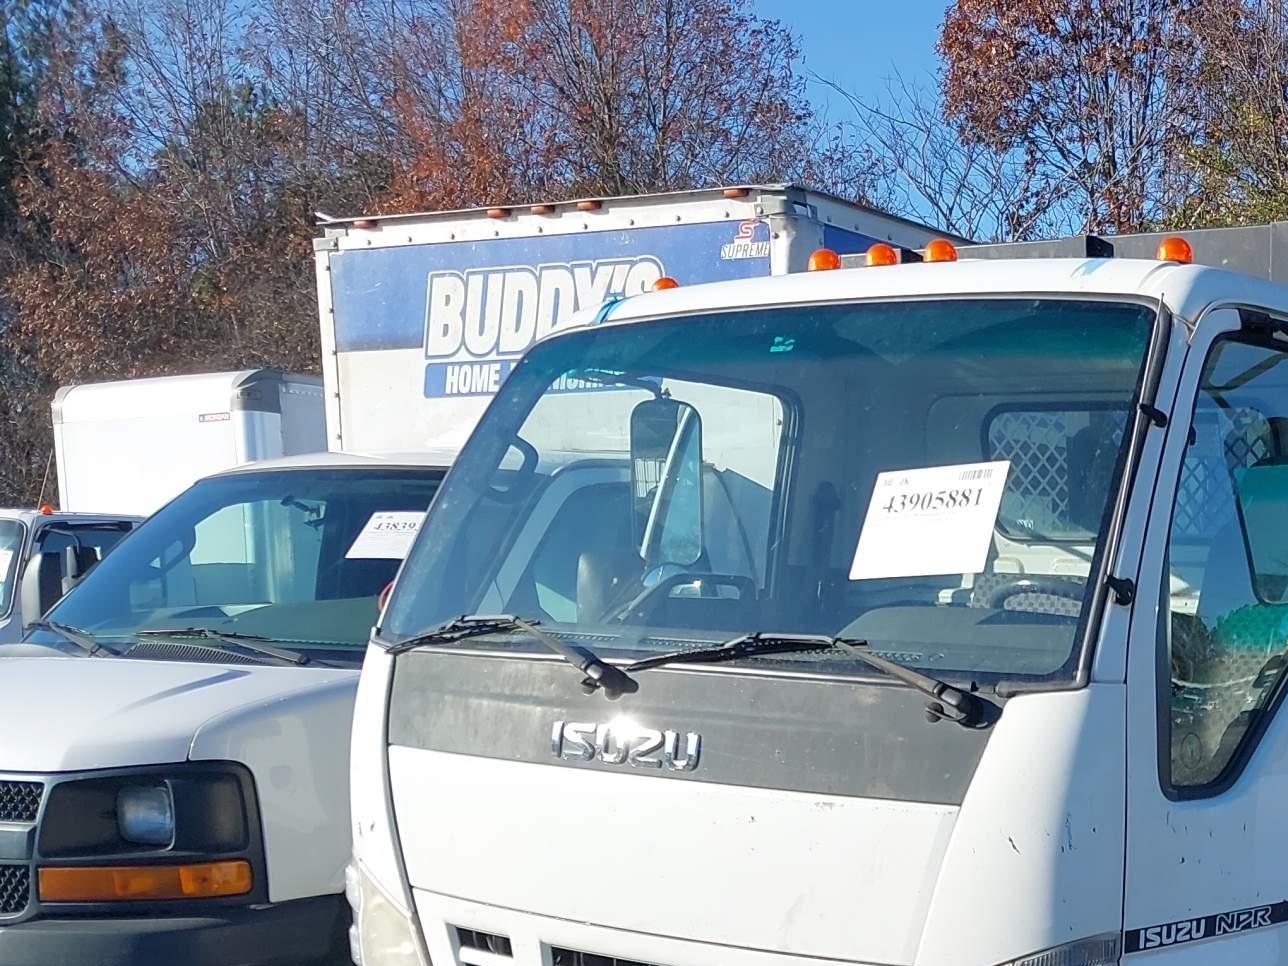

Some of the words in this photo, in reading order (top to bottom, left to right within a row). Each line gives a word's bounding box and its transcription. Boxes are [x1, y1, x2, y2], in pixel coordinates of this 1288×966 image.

[721, 241, 769, 259] SUPREME
[446, 363, 500, 394] HOME
[882, 487, 984, 513] 43905881
[551, 719, 702, 772] ISUZU
[1139, 918, 1206, 950] ISUZU
[1215, 905, 1272, 936] NPR
